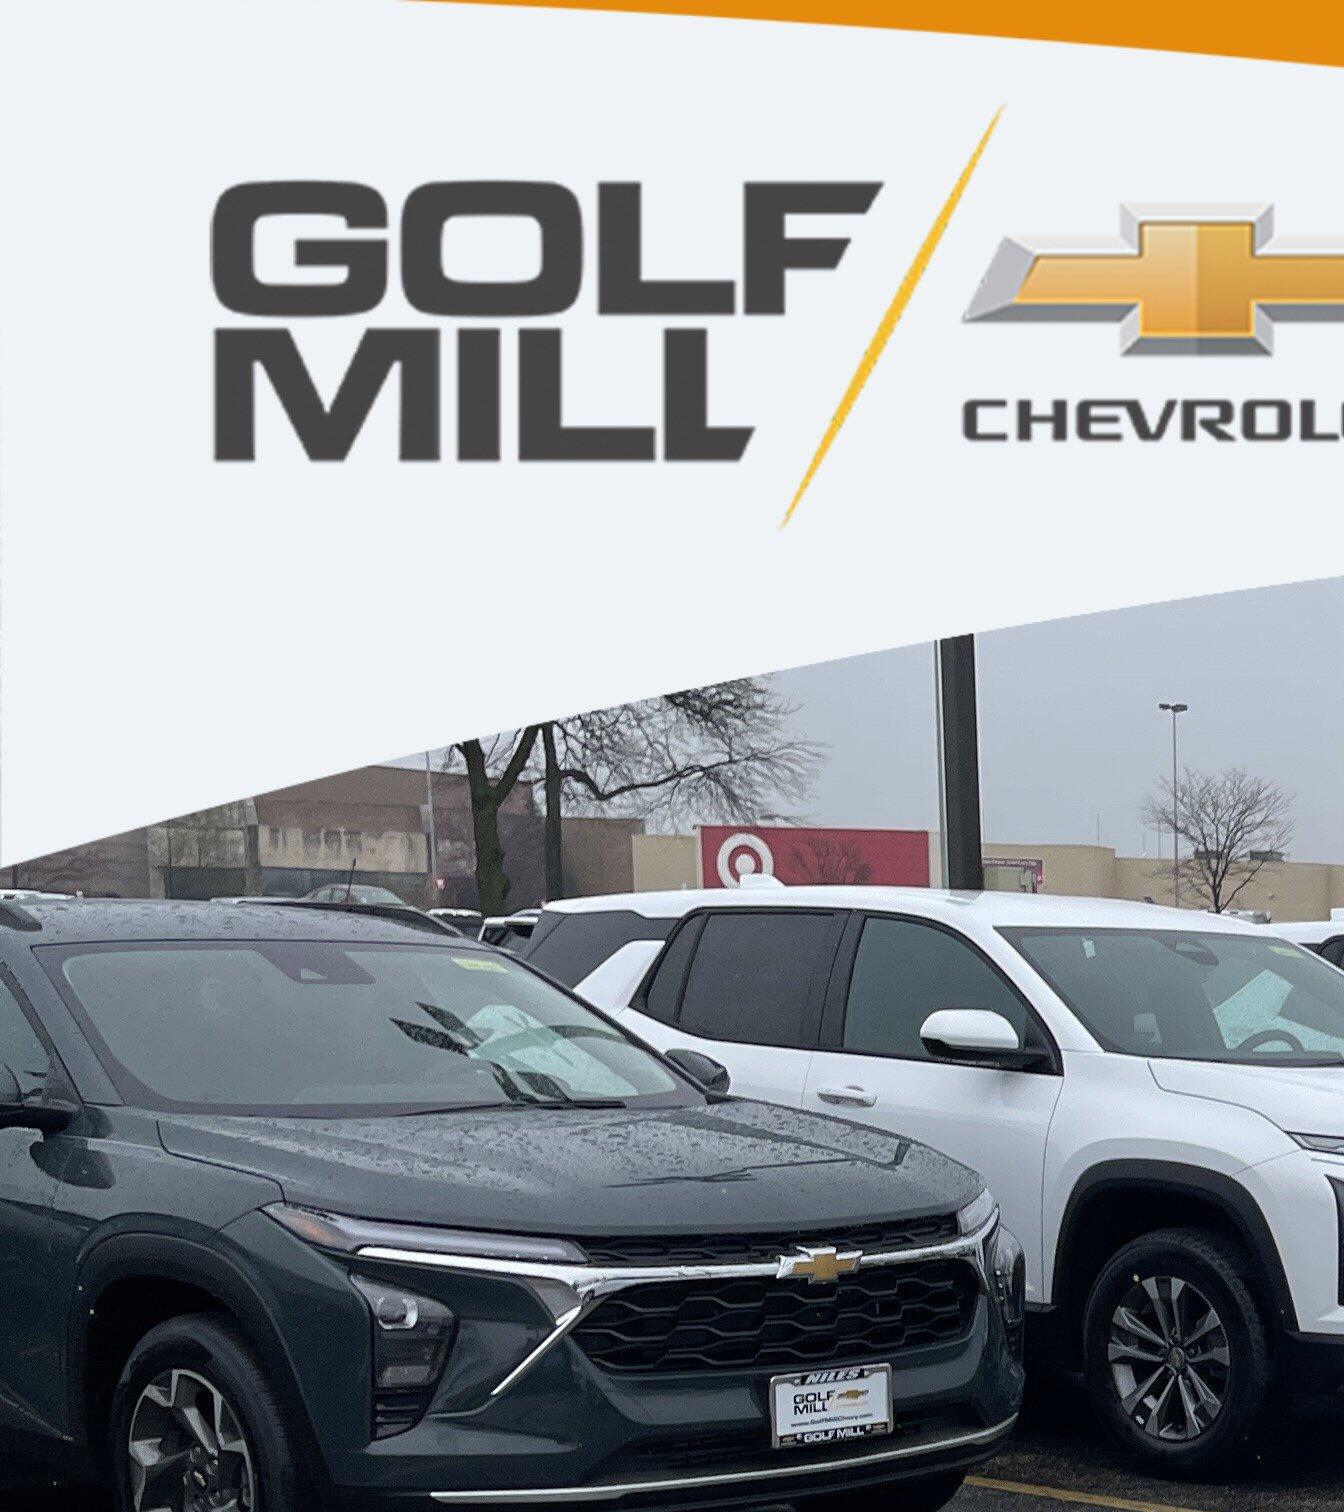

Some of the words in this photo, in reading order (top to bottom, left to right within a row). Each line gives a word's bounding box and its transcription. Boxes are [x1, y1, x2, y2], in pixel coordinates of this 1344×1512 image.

[805, 1369, 861, 1385] NILES
[793, 1390, 836, 1404] GOLF
[793, 1403, 828, 1416] MILL
[804, 1430, 834, 1443] GOLF
[836, 1427, 865, 1439] MILL
